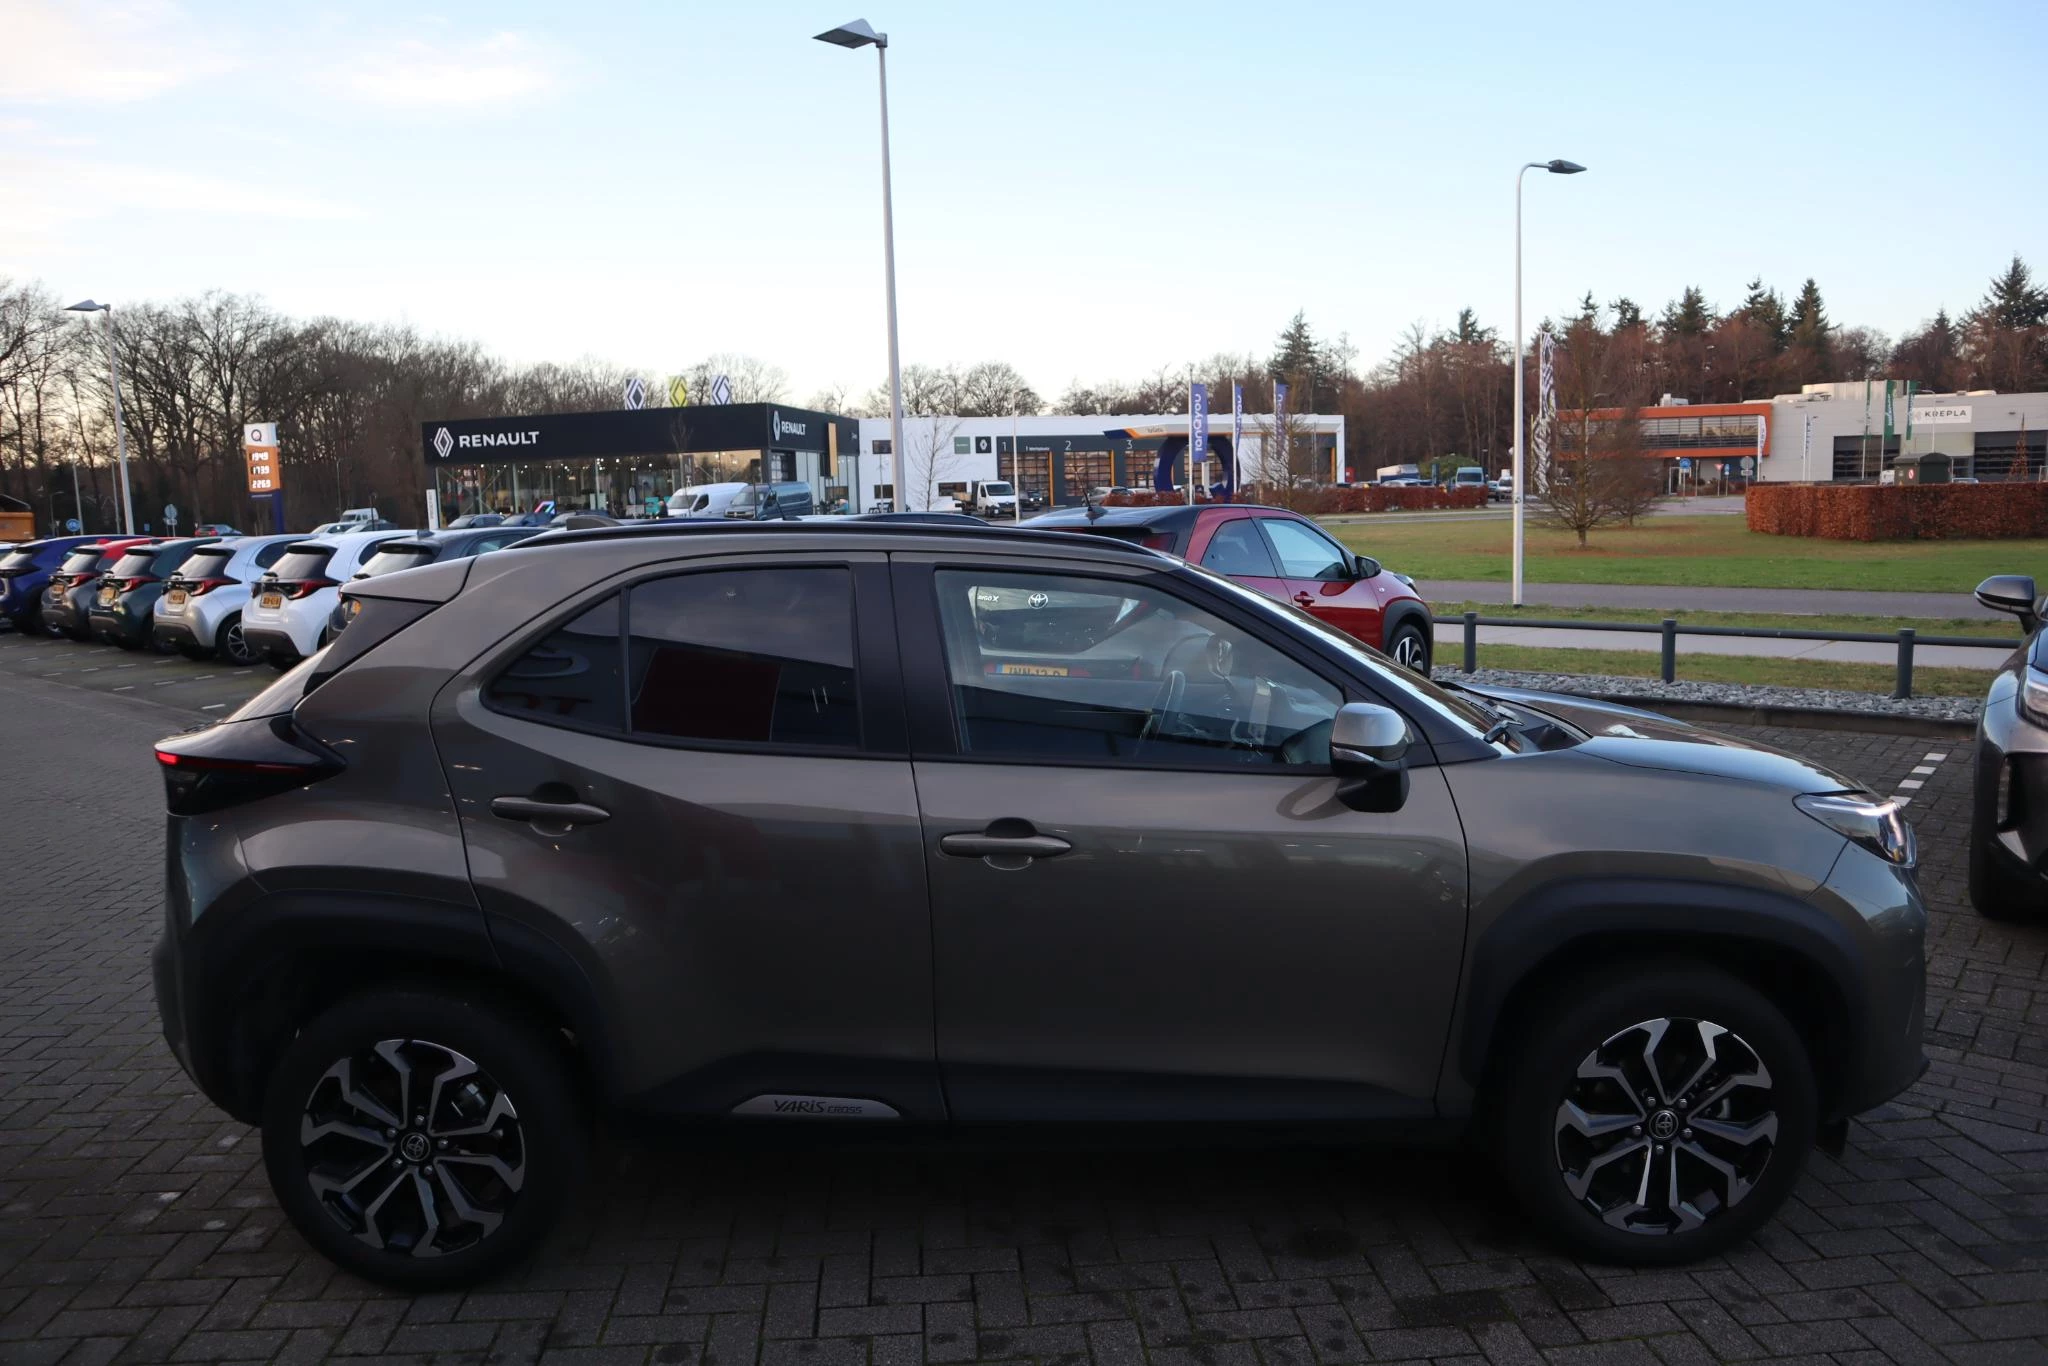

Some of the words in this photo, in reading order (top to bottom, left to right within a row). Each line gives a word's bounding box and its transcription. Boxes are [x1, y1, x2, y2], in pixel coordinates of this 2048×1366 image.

[781, 420, 806, 436] RENAULT
[458, 431, 540, 449] RENAULT
[1064, 440, 1072, 451] 2
[1126, 439, 1133, 450] 3
[1002, 441, 1007, 452] 1
